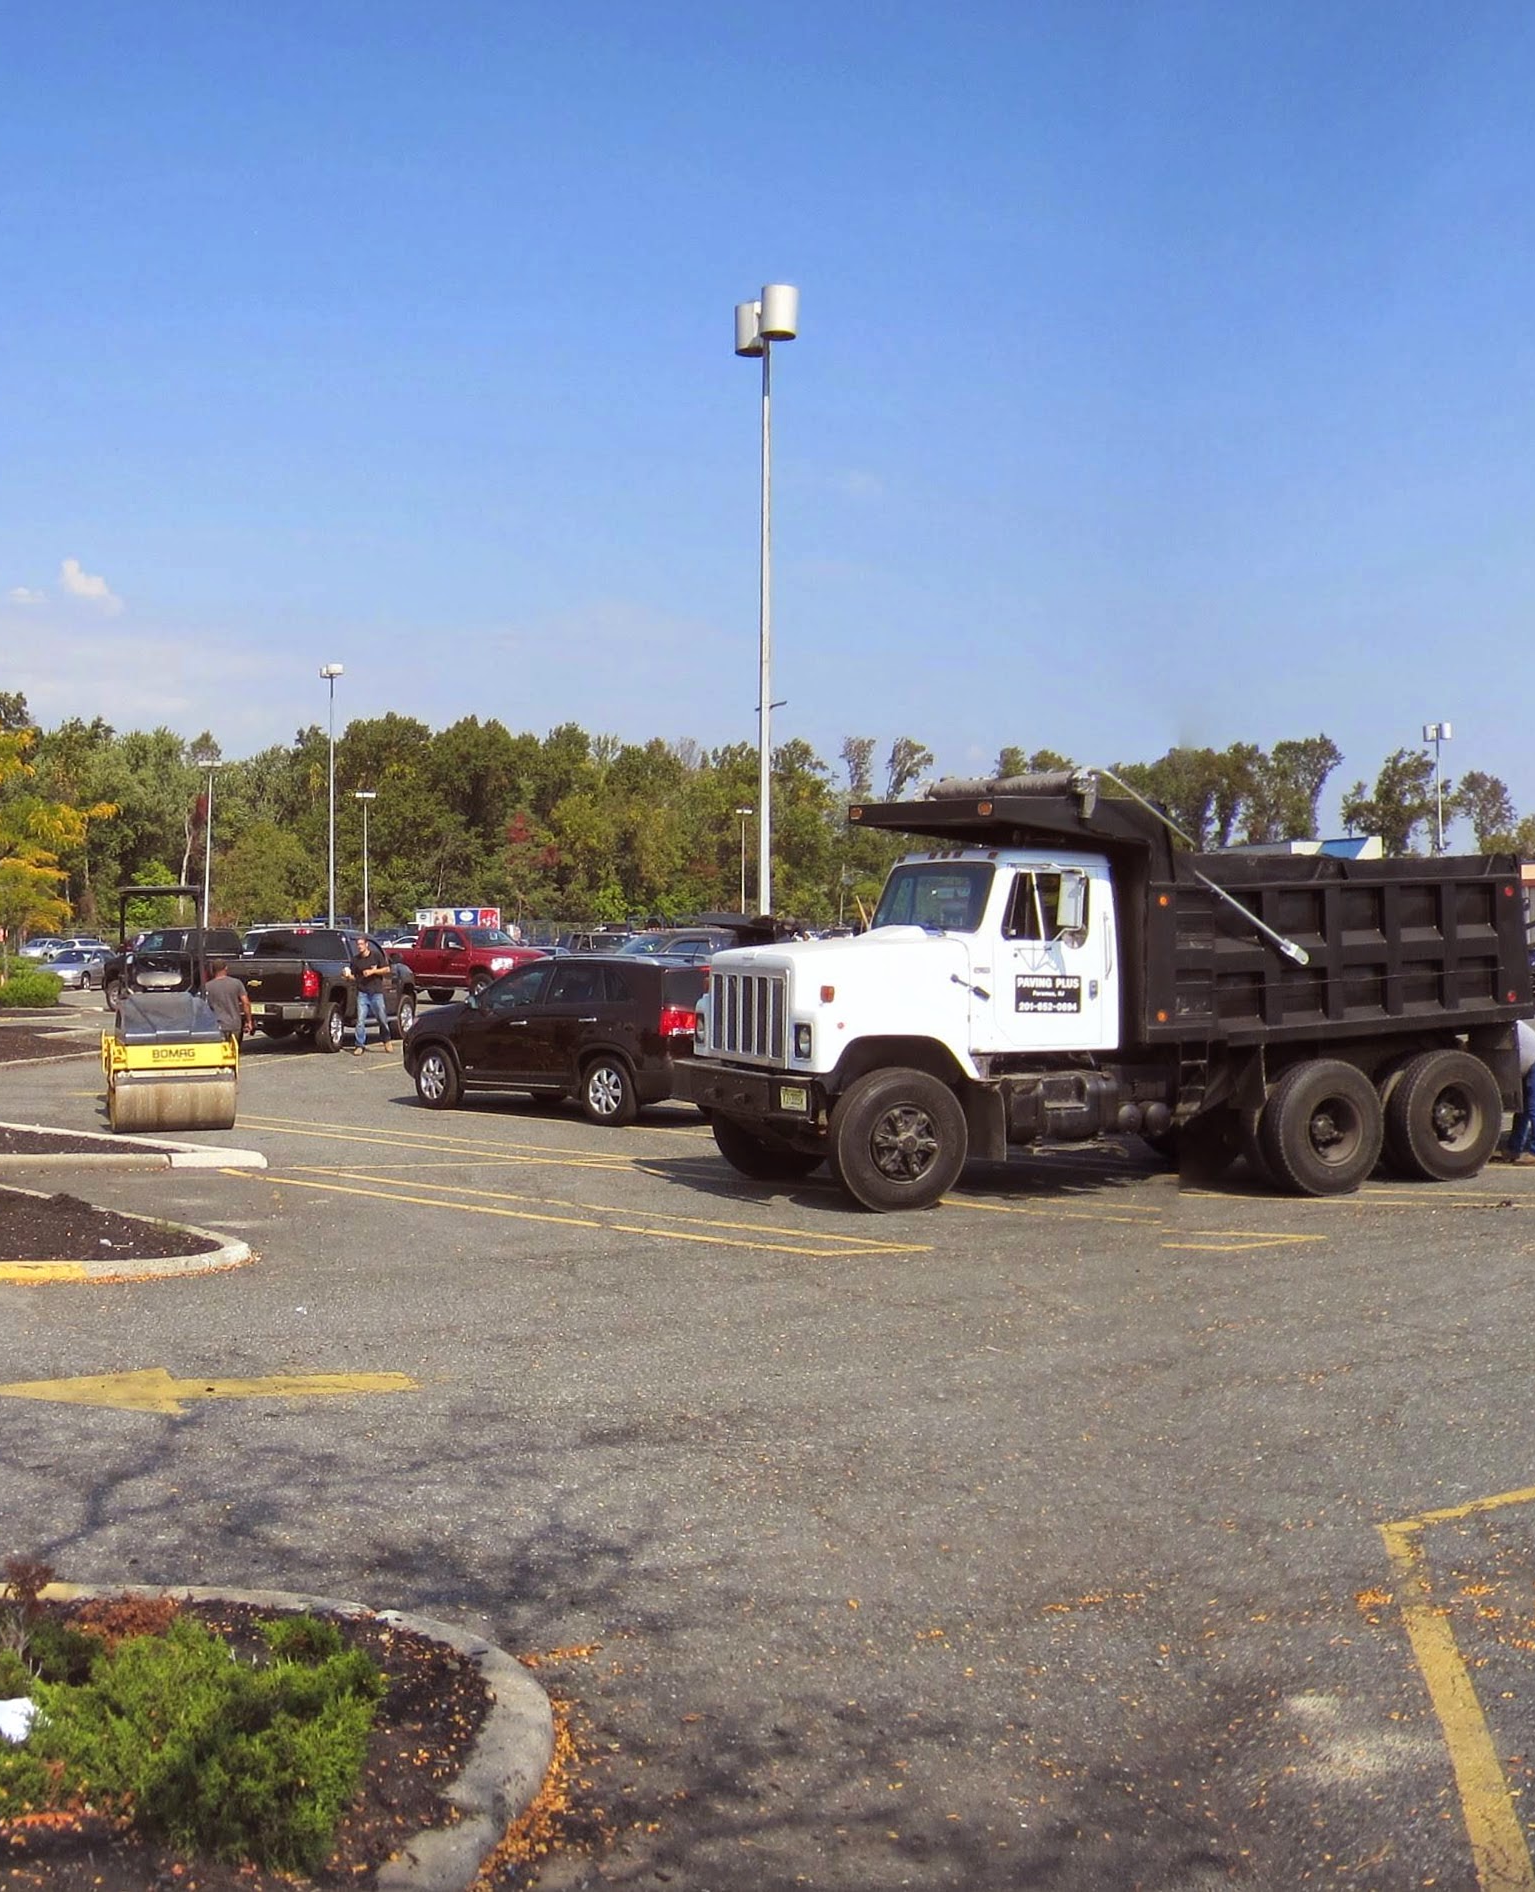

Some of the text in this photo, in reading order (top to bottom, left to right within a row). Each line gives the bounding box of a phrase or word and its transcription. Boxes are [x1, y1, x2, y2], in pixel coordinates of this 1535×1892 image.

[1017, 977, 1079, 989] PAVING PLUS
[152, 1048, 195, 1059] BOMAG
